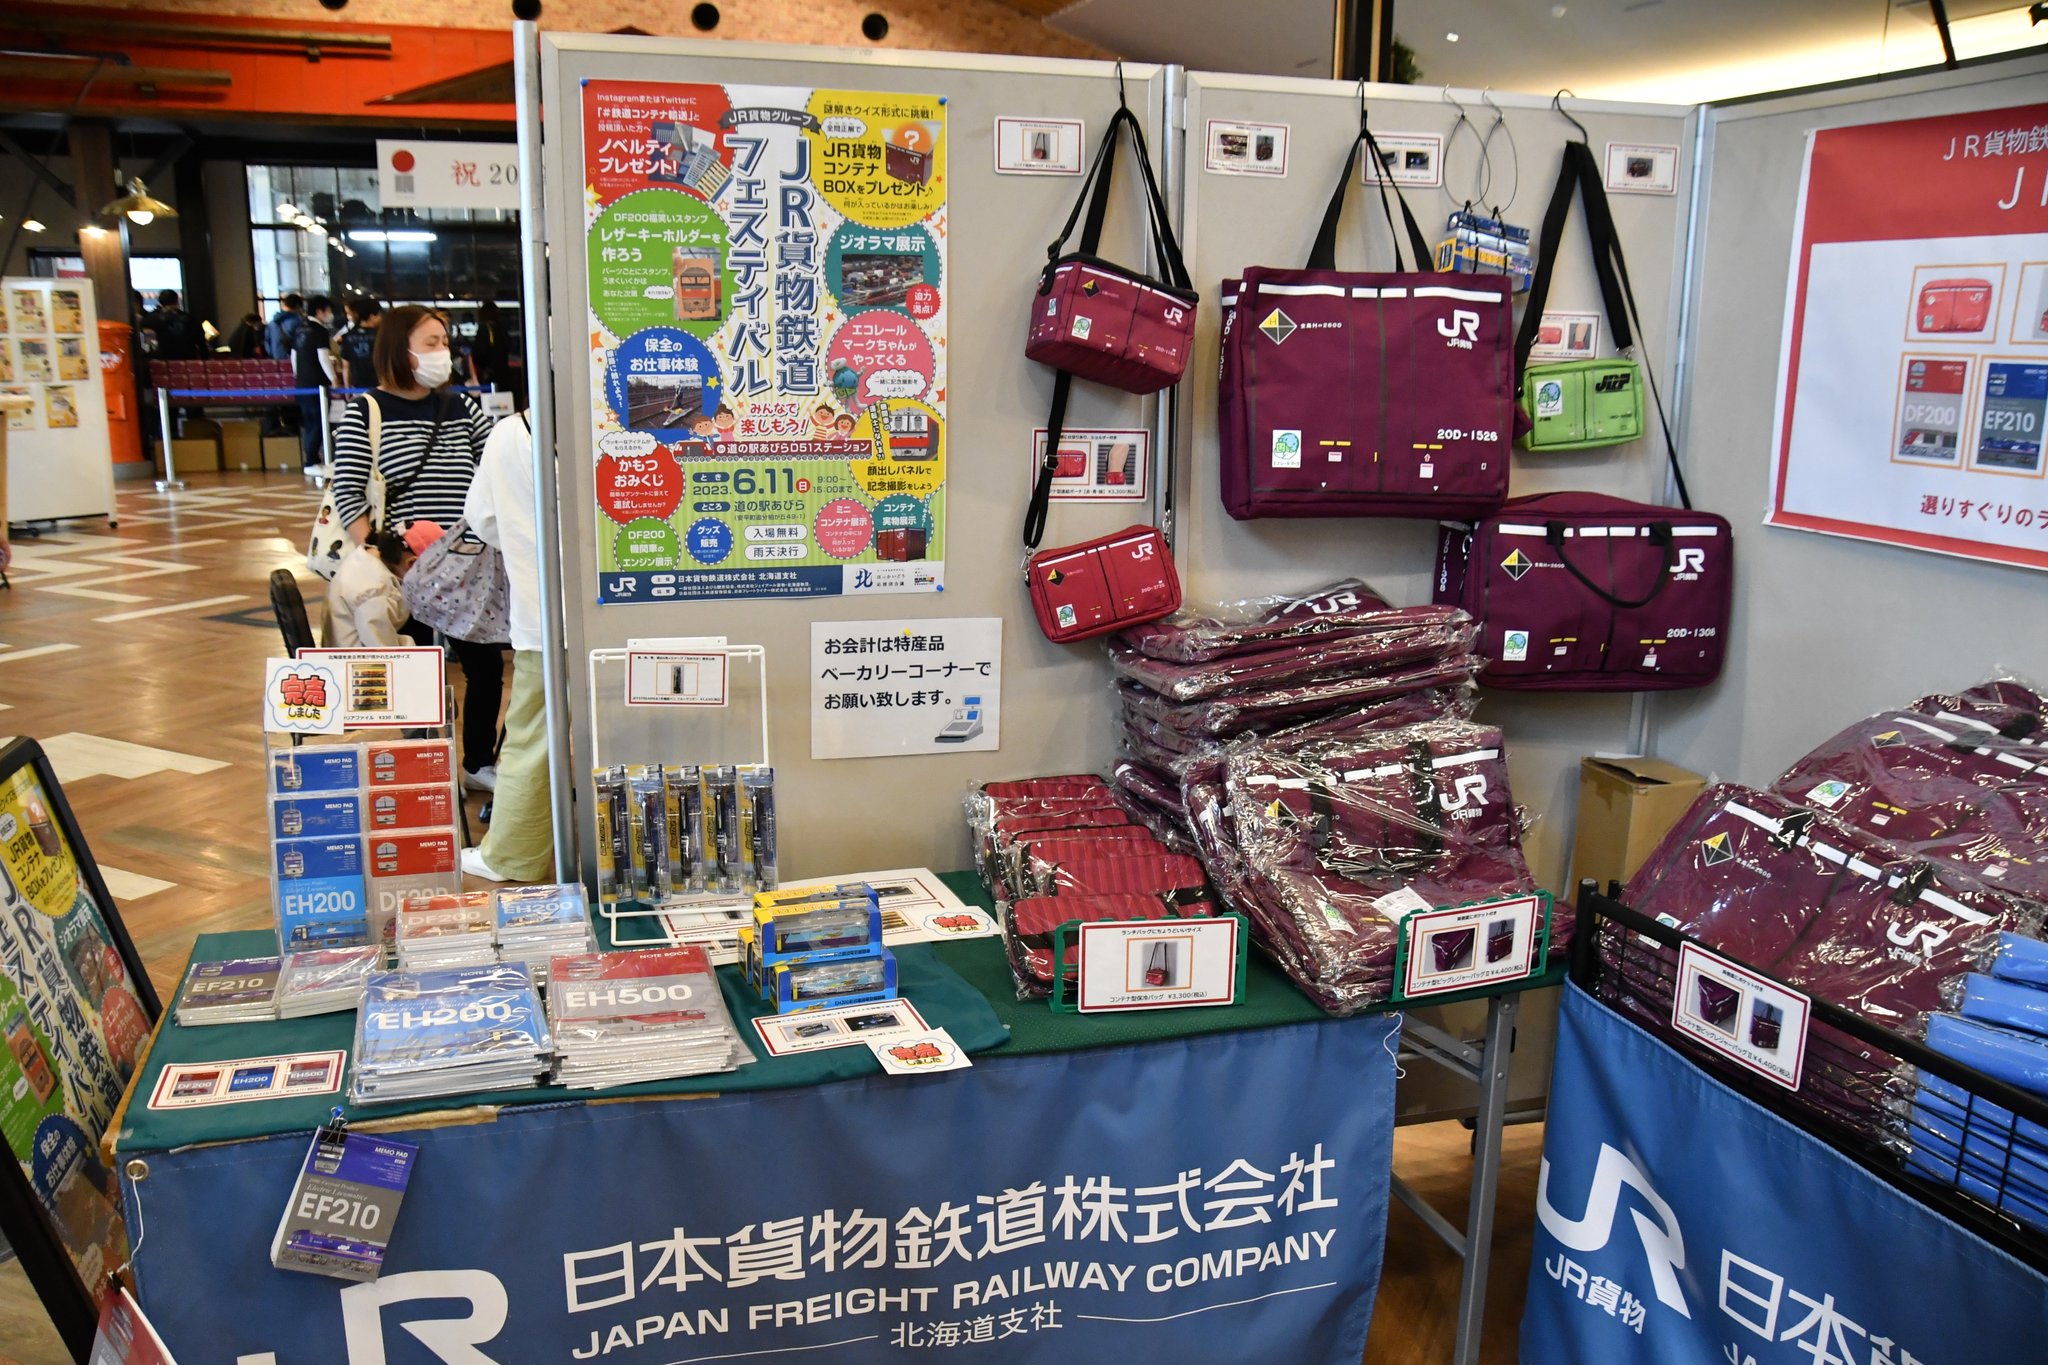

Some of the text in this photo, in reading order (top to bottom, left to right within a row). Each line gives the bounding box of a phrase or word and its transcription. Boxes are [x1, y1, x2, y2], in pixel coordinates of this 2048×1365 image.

[597, 93, 696, 105] InstagramまたはTwitterに
[729, 109, 813, 127] JR貨物グループ
[598, 138, 671, 156] ノベルティ
[823, 142, 881, 160] JR貨物
[452, 160, 481, 187] 祝
[824, 162, 879, 176] コンテナ
[601, 228, 721, 244] レザーキーホルダーを
[839, 235, 926, 252] ジオラマ展示
[601, 247, 643, 263] 作ろう
[726, 137, 768, 395] フェスティバル
[775, 137, 816, 394] JR貨物鉄道
[603, 277, 647, 285] うまくいくかは
[914, 291, 932, 302] 迫力
[1163, 306, 1183, 324] JR
[852, 324, 907, 336] エコレール
[1437, 309, 1480, 341] JR
[645, 338, 683, 353] 保全の
[842, 339, 917, 352] マークちゃんが
[630, 357, 699, 373] お仕事体験
[852, 354, 907, 366] やってくる
[750, 402, 797, 415] みんなで
[1905, 404, 1956, 426] DF200
[1984, 410, 2035, 433] EF210
[1436, 428, 1498, 442] 20D-1526
[619, 460, 659, 472] かもつ
[867, 465, 932, 476] 顔出しパネルで
[614, 475, 664, 488] おみくじ
[867, 480, 932, 492] 記念撮影をしよう
[701, 500, 805, 512] ところ 道の駅あびら
[836, 505, 851, 514] ミニ
[884, 503, 916, 512] コンテナ
[697, 525, 721, 535] グッズ
[820, 517, 868, 527] コンテナ展示
[628, 530, 666, 540] DF200
[753, 527, 799, 539] 入場無料
[700, 539, 718, 548] 販売
[753, 546, 799, 557] 雨天決行
[1131, 542, 1153, 559] JR
[622, 557, 673, 568] エンジン展示
[1668, 548, 1705, 573] JR
[609, 577, 637, 593] JR
[678, 572, 798, 584] 日本貨物鉄道株式会社 北海道支社
[824, 635, 945, 655] お会計は特産品
[821, 661, 992, 683] ベーカリーコーナーで
[280, 673, 327, 707] 完売
[824, 690, 954, 711] お願い致します。
[288, 707, 321, 720] しました
[1438, 775, 1489, 811] JR
[286, 890, 357, 916] EH200
[503, 901, 573, 915] EH200
[409, 911, 481, 926] DF200
[1121, 927, 1203, 936] ランチバッグにちょうどいいサイズ
[639, 950, 690, 960] NOTE BOOK
[191, 977, 264, 994] EF210
[565, 985, 692, 1008] EH500
[1109, 993, 1164, 1003] コンテナ型保冷バッグ
[378, 1003, 512, 1031] EH200
[177, 1070, 324, 1090] DF200 EH200 EH500
[374, 1146, 409, 1159] MEMO PAD
[297, 1192, 381, 1230] EF210
[563, 1142, 1339, 1314] 日本貨物鉄道株式会社
[1536, 1142, 1691, 1320] JR
[572, 1228, 1338, 1361] JAPAN FREIGHT RAILWAY COMPANY
[1545, 1253, 1647, 1335] JR貨物
[890, 1300, 1063, 1349] 北海道支社
